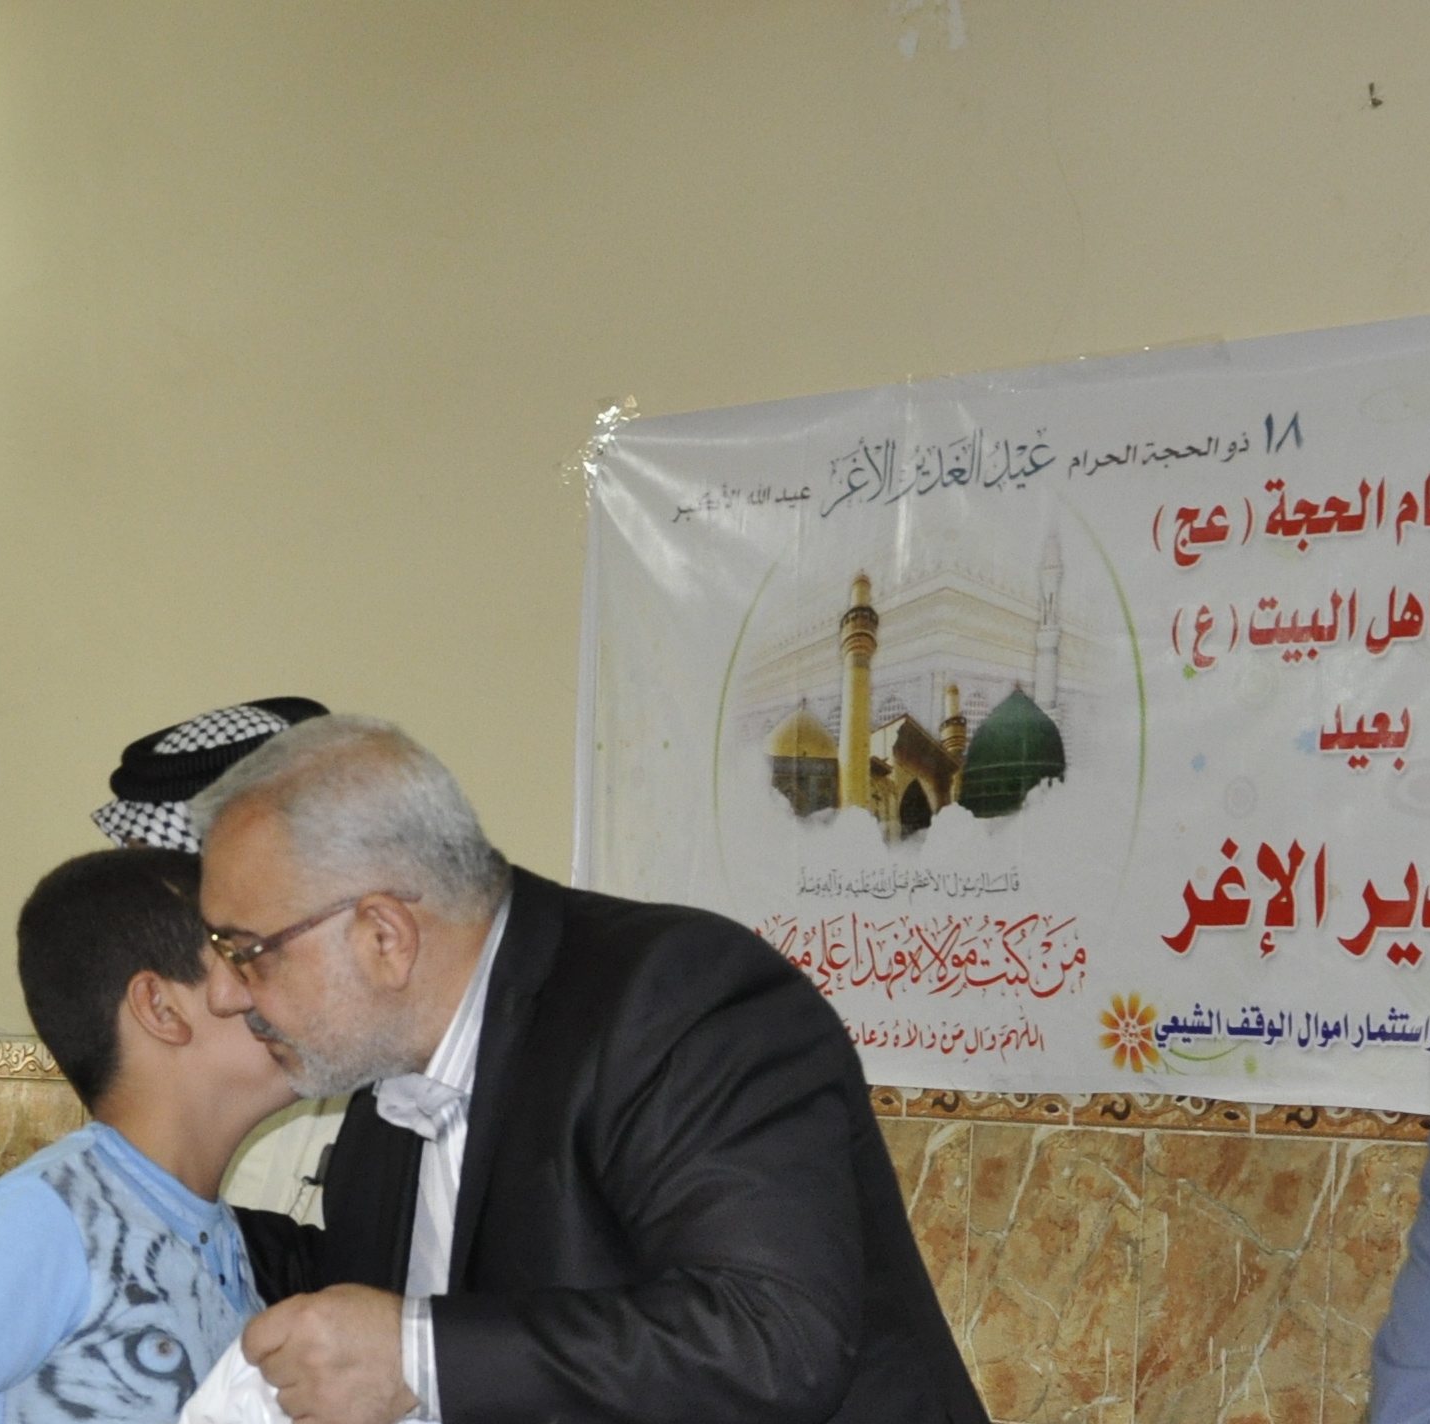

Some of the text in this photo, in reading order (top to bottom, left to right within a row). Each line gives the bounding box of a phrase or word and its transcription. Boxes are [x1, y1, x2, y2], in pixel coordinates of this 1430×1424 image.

[1068, 444, 1138, 479] الحرام
[1142, 437, 1220, 468] الحجة
[1265, 476, 1386, 554] الحجة
[1248, 587, 1358, 664] البيت
[1318, 703, 1411, 770] بعيد
[1154, 1003, 1221, 1048] الشيعي
[1226, 1006, 1293, 1046] الوقف
[1297, 1010, 1349, 1048] اموال
